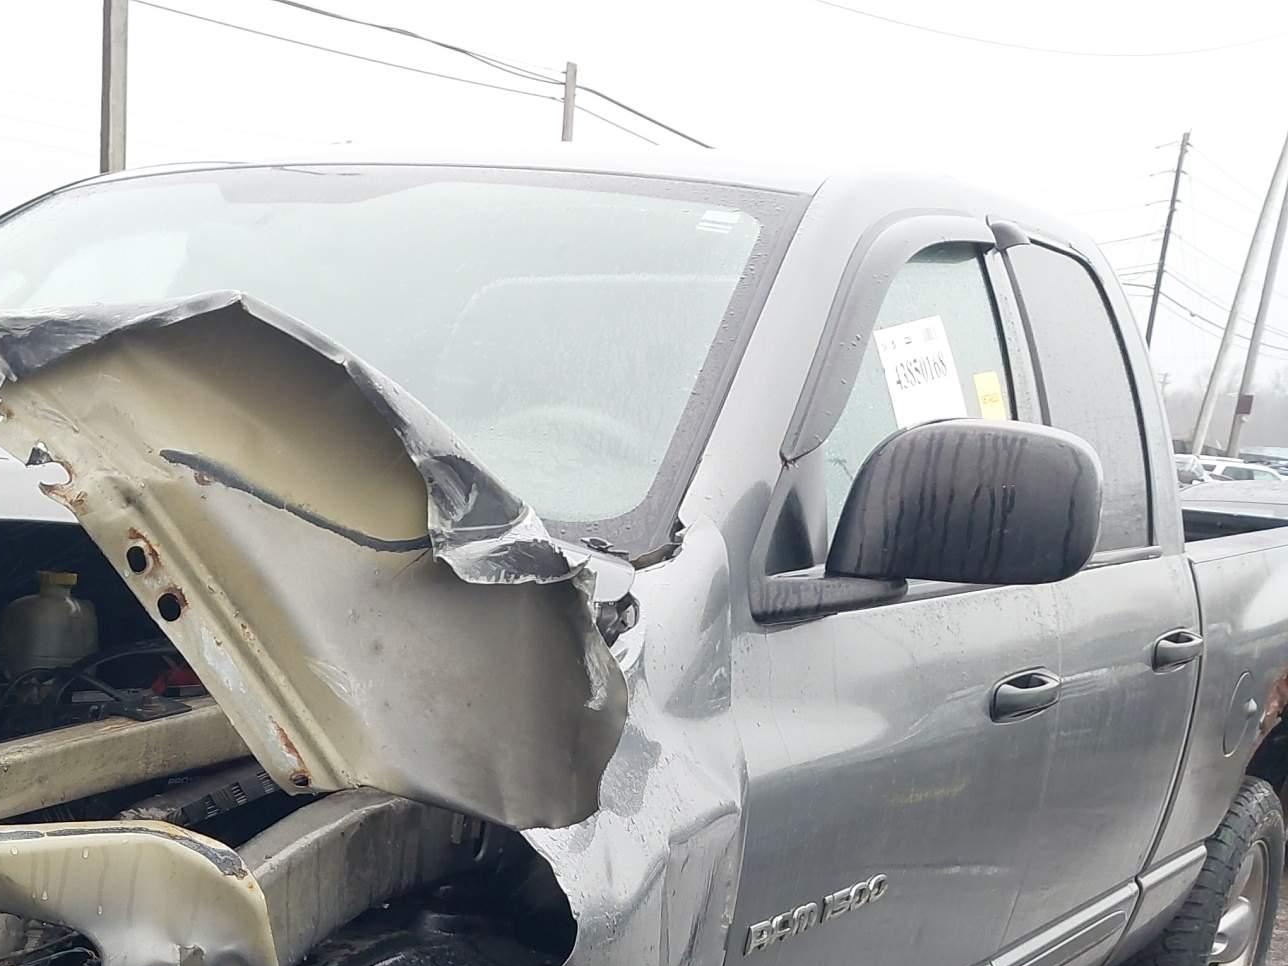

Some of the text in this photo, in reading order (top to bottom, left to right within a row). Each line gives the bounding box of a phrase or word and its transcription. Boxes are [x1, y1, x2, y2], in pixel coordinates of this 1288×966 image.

[894, 350, 949, 391] 43850168
[742, 873, 890, 957] RAM 1500
